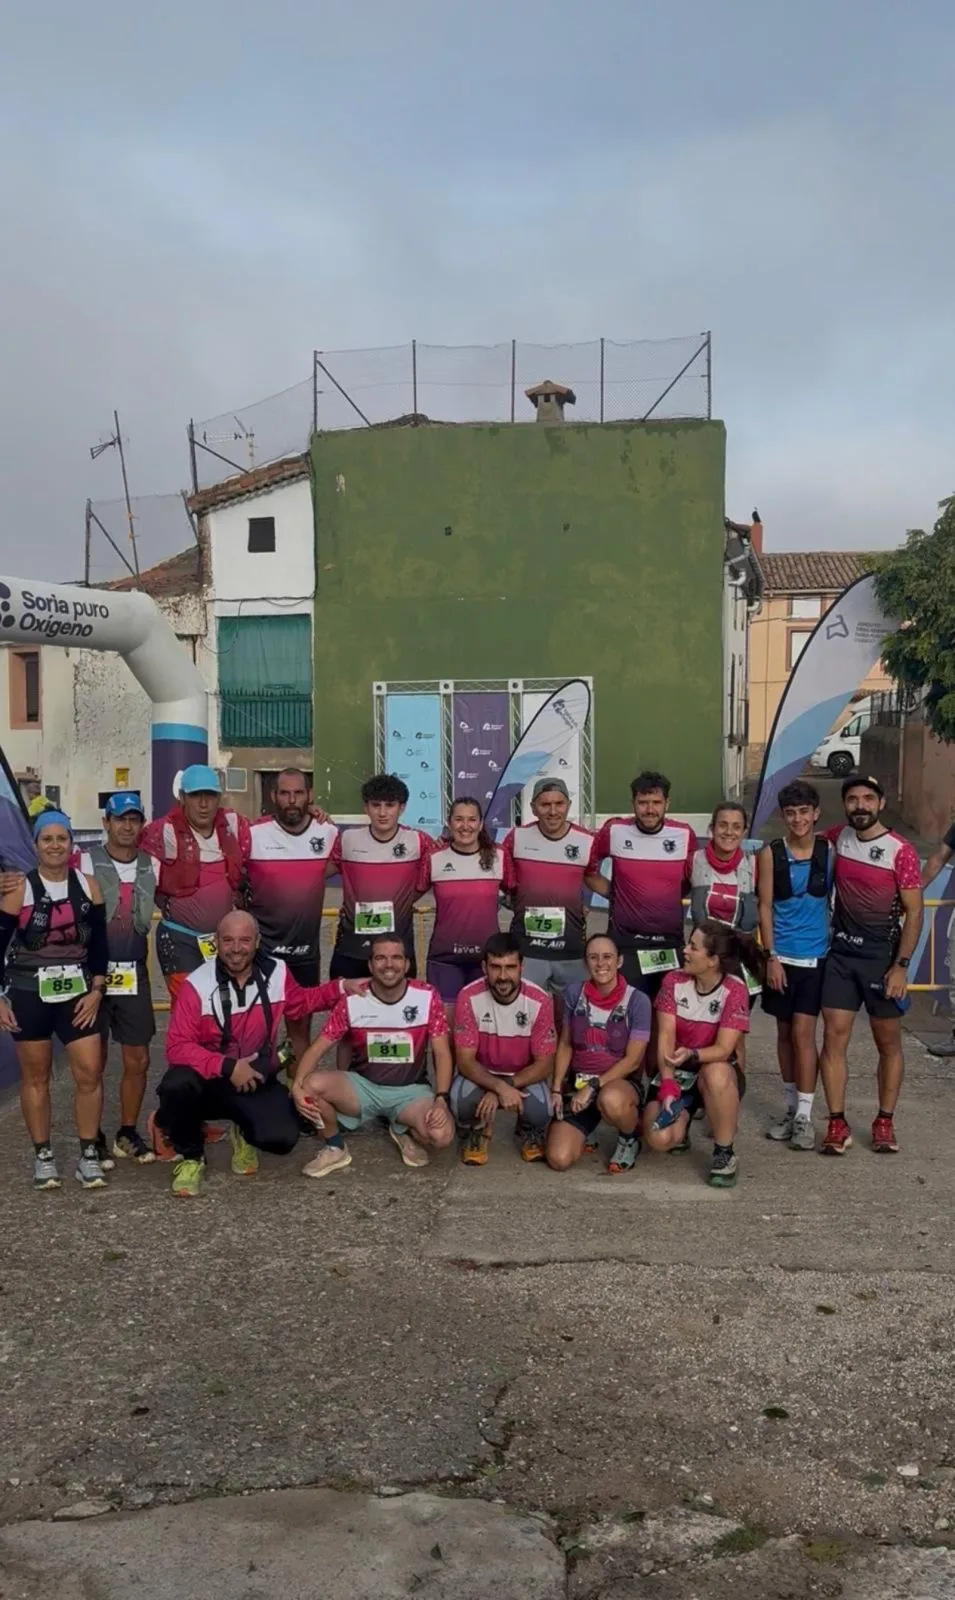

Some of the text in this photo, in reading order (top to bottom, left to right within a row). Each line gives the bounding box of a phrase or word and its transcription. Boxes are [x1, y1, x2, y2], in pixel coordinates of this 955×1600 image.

[21, 590, 109, 621] Soria puro
[19, 612, 93, 637] Oxígeno
[364, 914, 381, 925] 74
[535, 919, 552, 930] 75
[52, 978, 73, 992] 85
[104, 974, 124, 985] 32
[380, 1044, 398, 1055] 81
